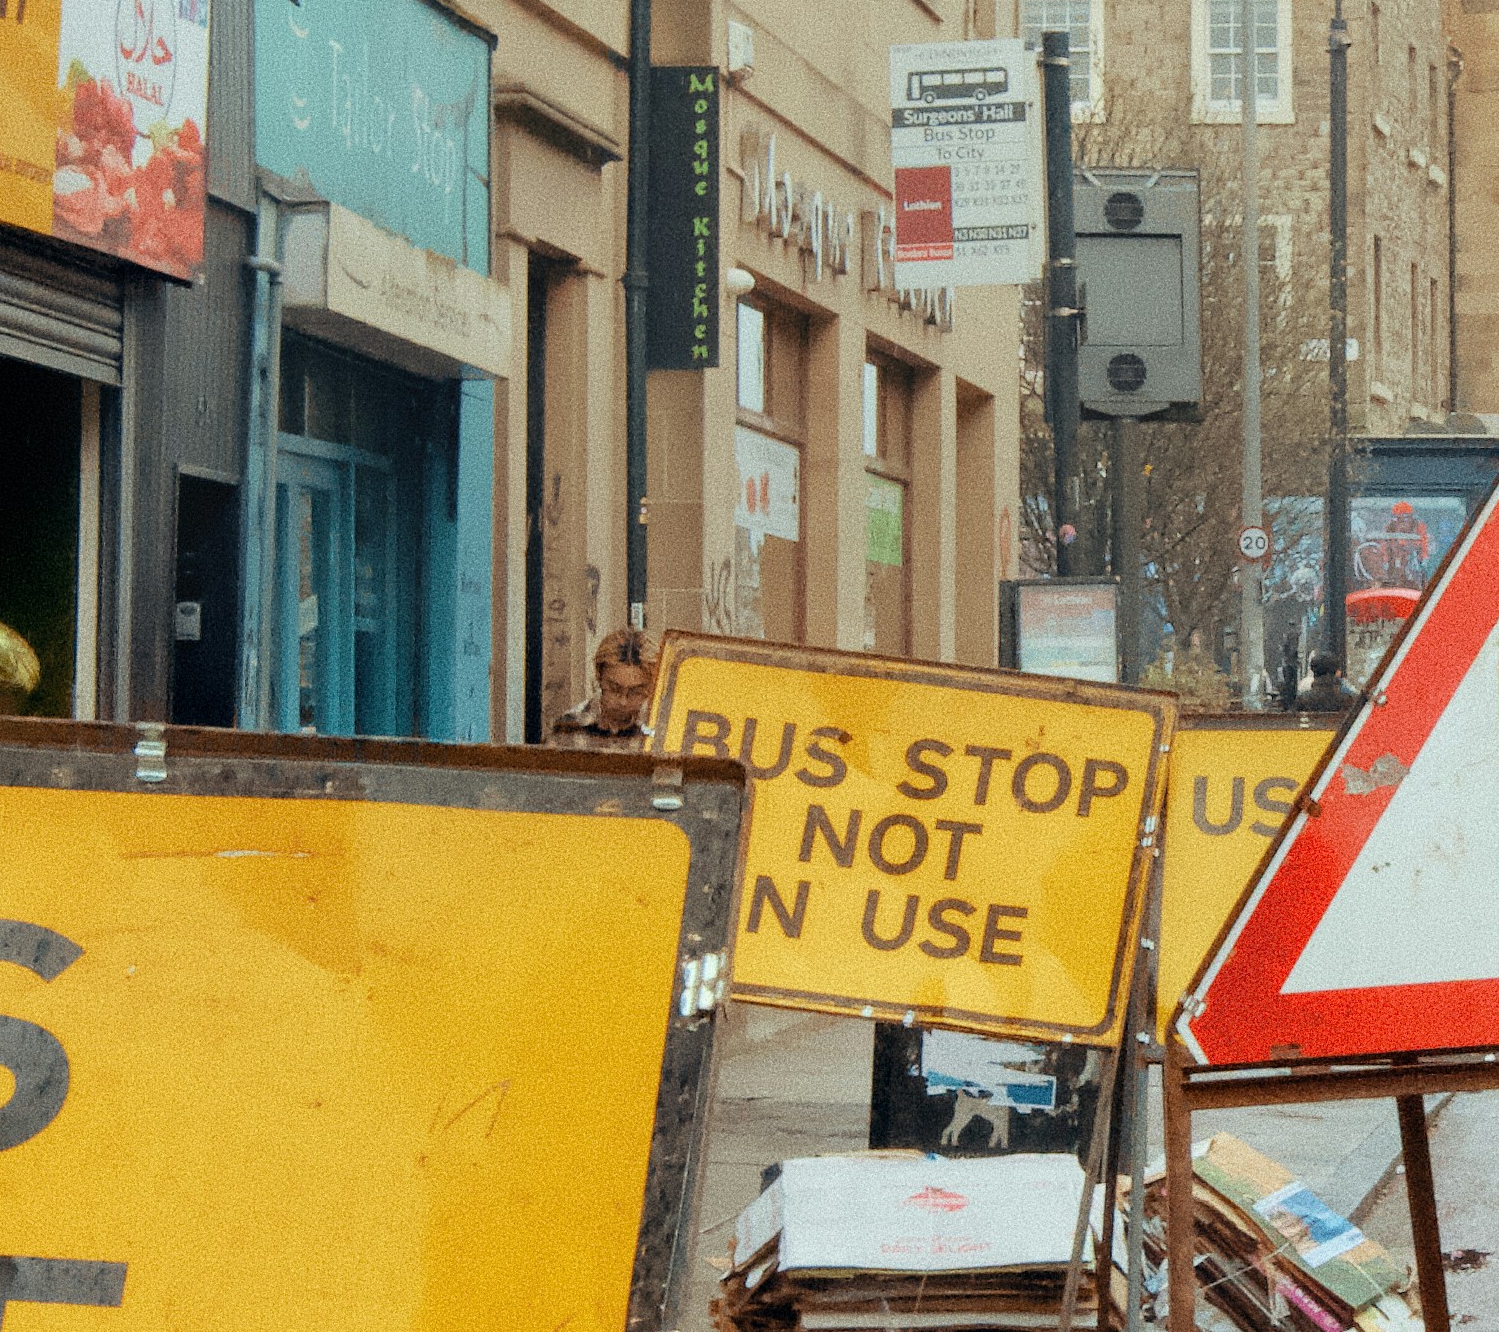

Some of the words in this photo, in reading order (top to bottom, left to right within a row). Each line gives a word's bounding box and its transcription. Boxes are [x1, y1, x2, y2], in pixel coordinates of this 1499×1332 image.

[126, 71, 165, 107] HALAL
[903, 106, 980, 127] Surgeons'
[982, 103, 1014, 121] Hall
[688, 72, 715, 197] Mosque
[924, 128, 953, 143] Bus
[957, 125, 995, 145] Stop
[937, 147, 952, 160] To
[956, 145, 985, 163] City
[903, 199, 942, 212] Lothian
[691, 216, 710, 360] Kitchen
[1242, 536, 1266, 550] 20
[680, 710, 850, 788] BUS
[896, 738, 1129, 817] STOP
[798, 804, 983, 881] NOT
[860, 887, 1029, 966] USE
